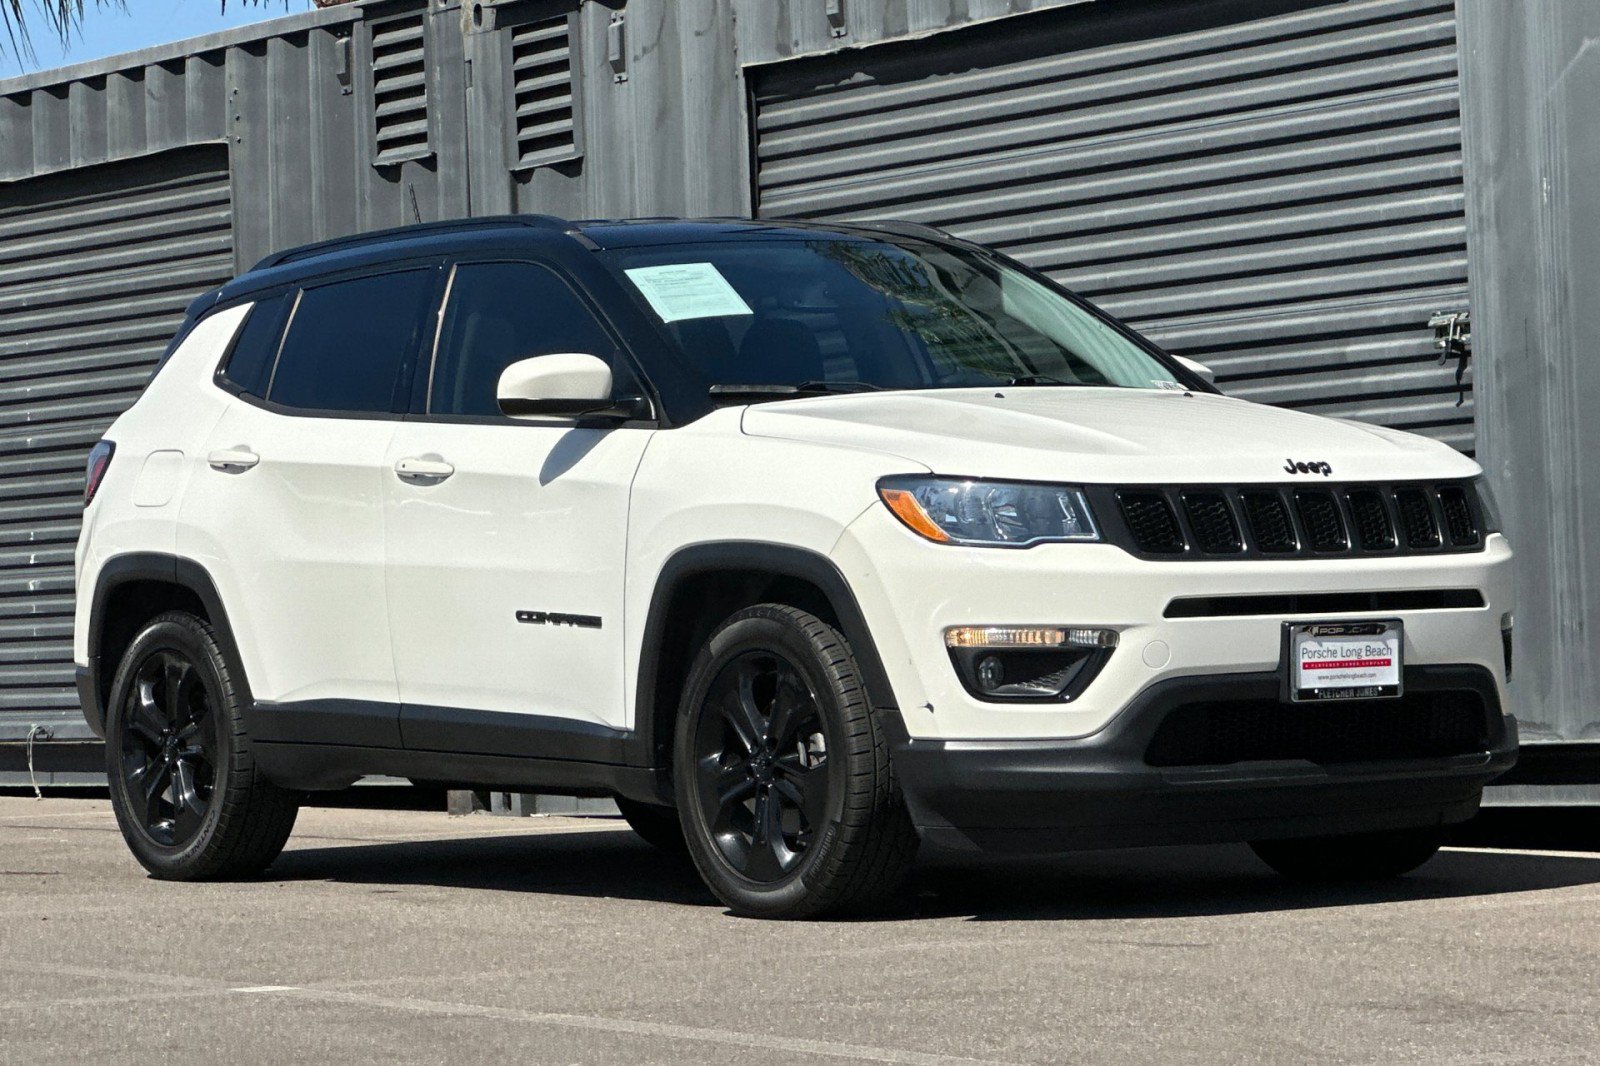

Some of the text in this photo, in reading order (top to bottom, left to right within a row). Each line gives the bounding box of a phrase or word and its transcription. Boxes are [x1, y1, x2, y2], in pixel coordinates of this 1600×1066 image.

[1283, 458, 1332, 477] Jeep
[1302, 645, 1392, 659] Porsche Long Beach
